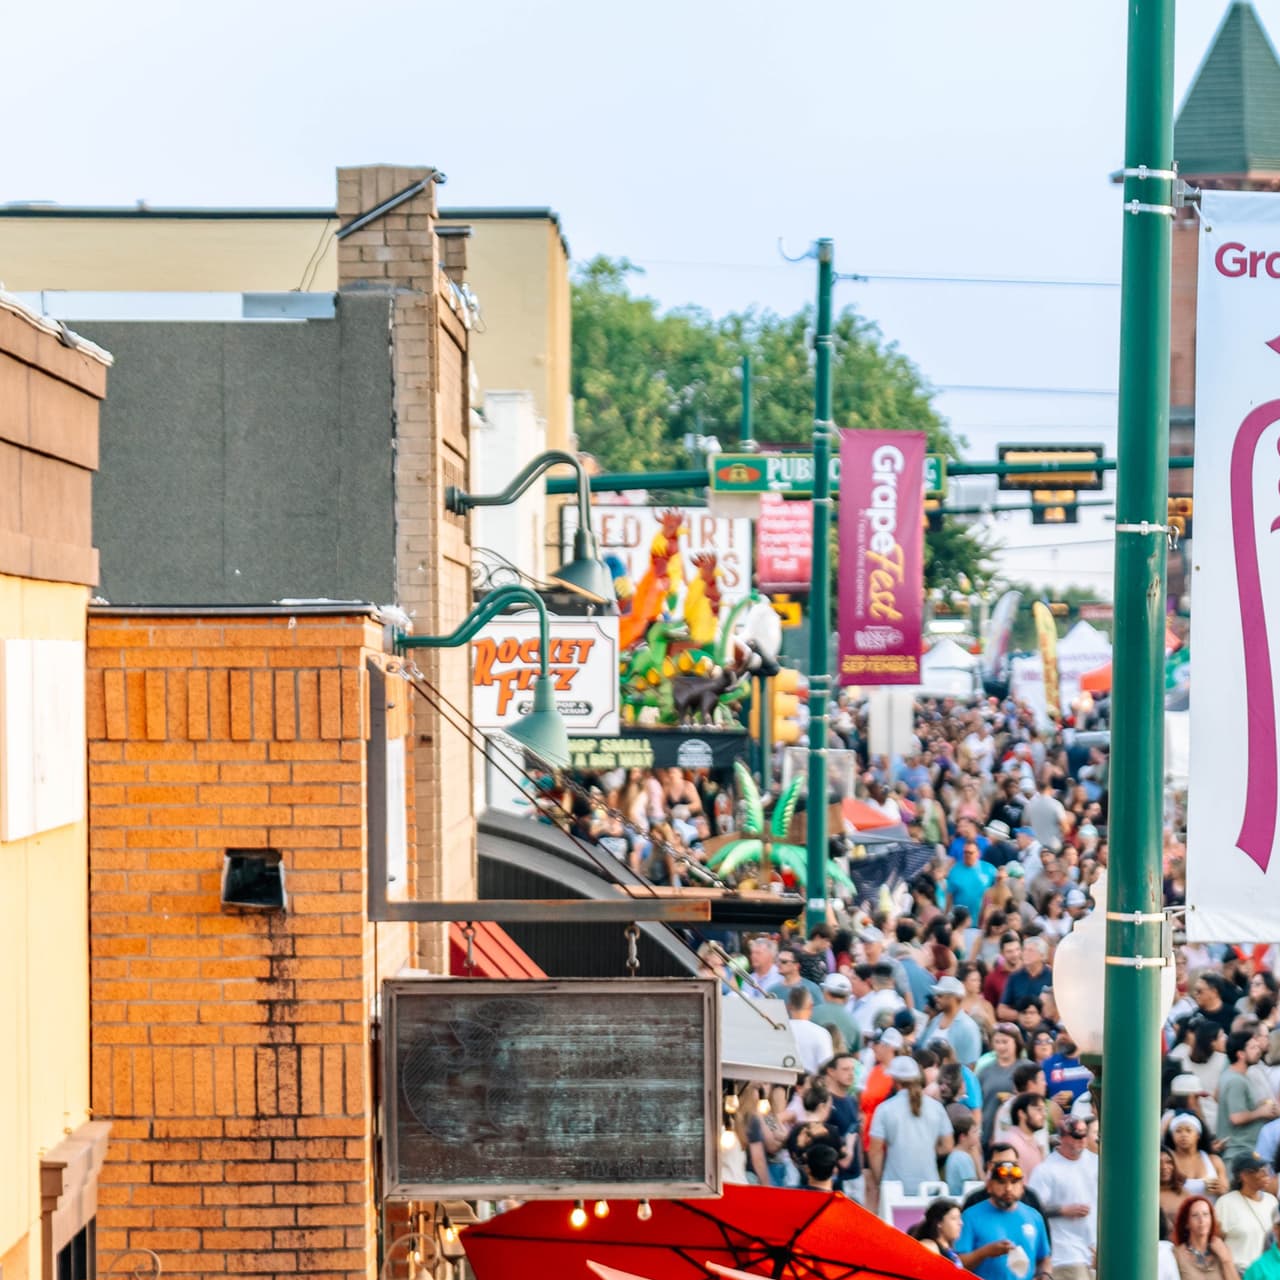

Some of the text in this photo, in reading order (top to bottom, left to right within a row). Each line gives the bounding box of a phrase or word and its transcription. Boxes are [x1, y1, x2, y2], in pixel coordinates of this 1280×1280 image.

[767, 457, 841, 482] PUBC
[864, 444, 905, 621] GrapeFest
[842, 661, 918, 673] SEPTEMBER
